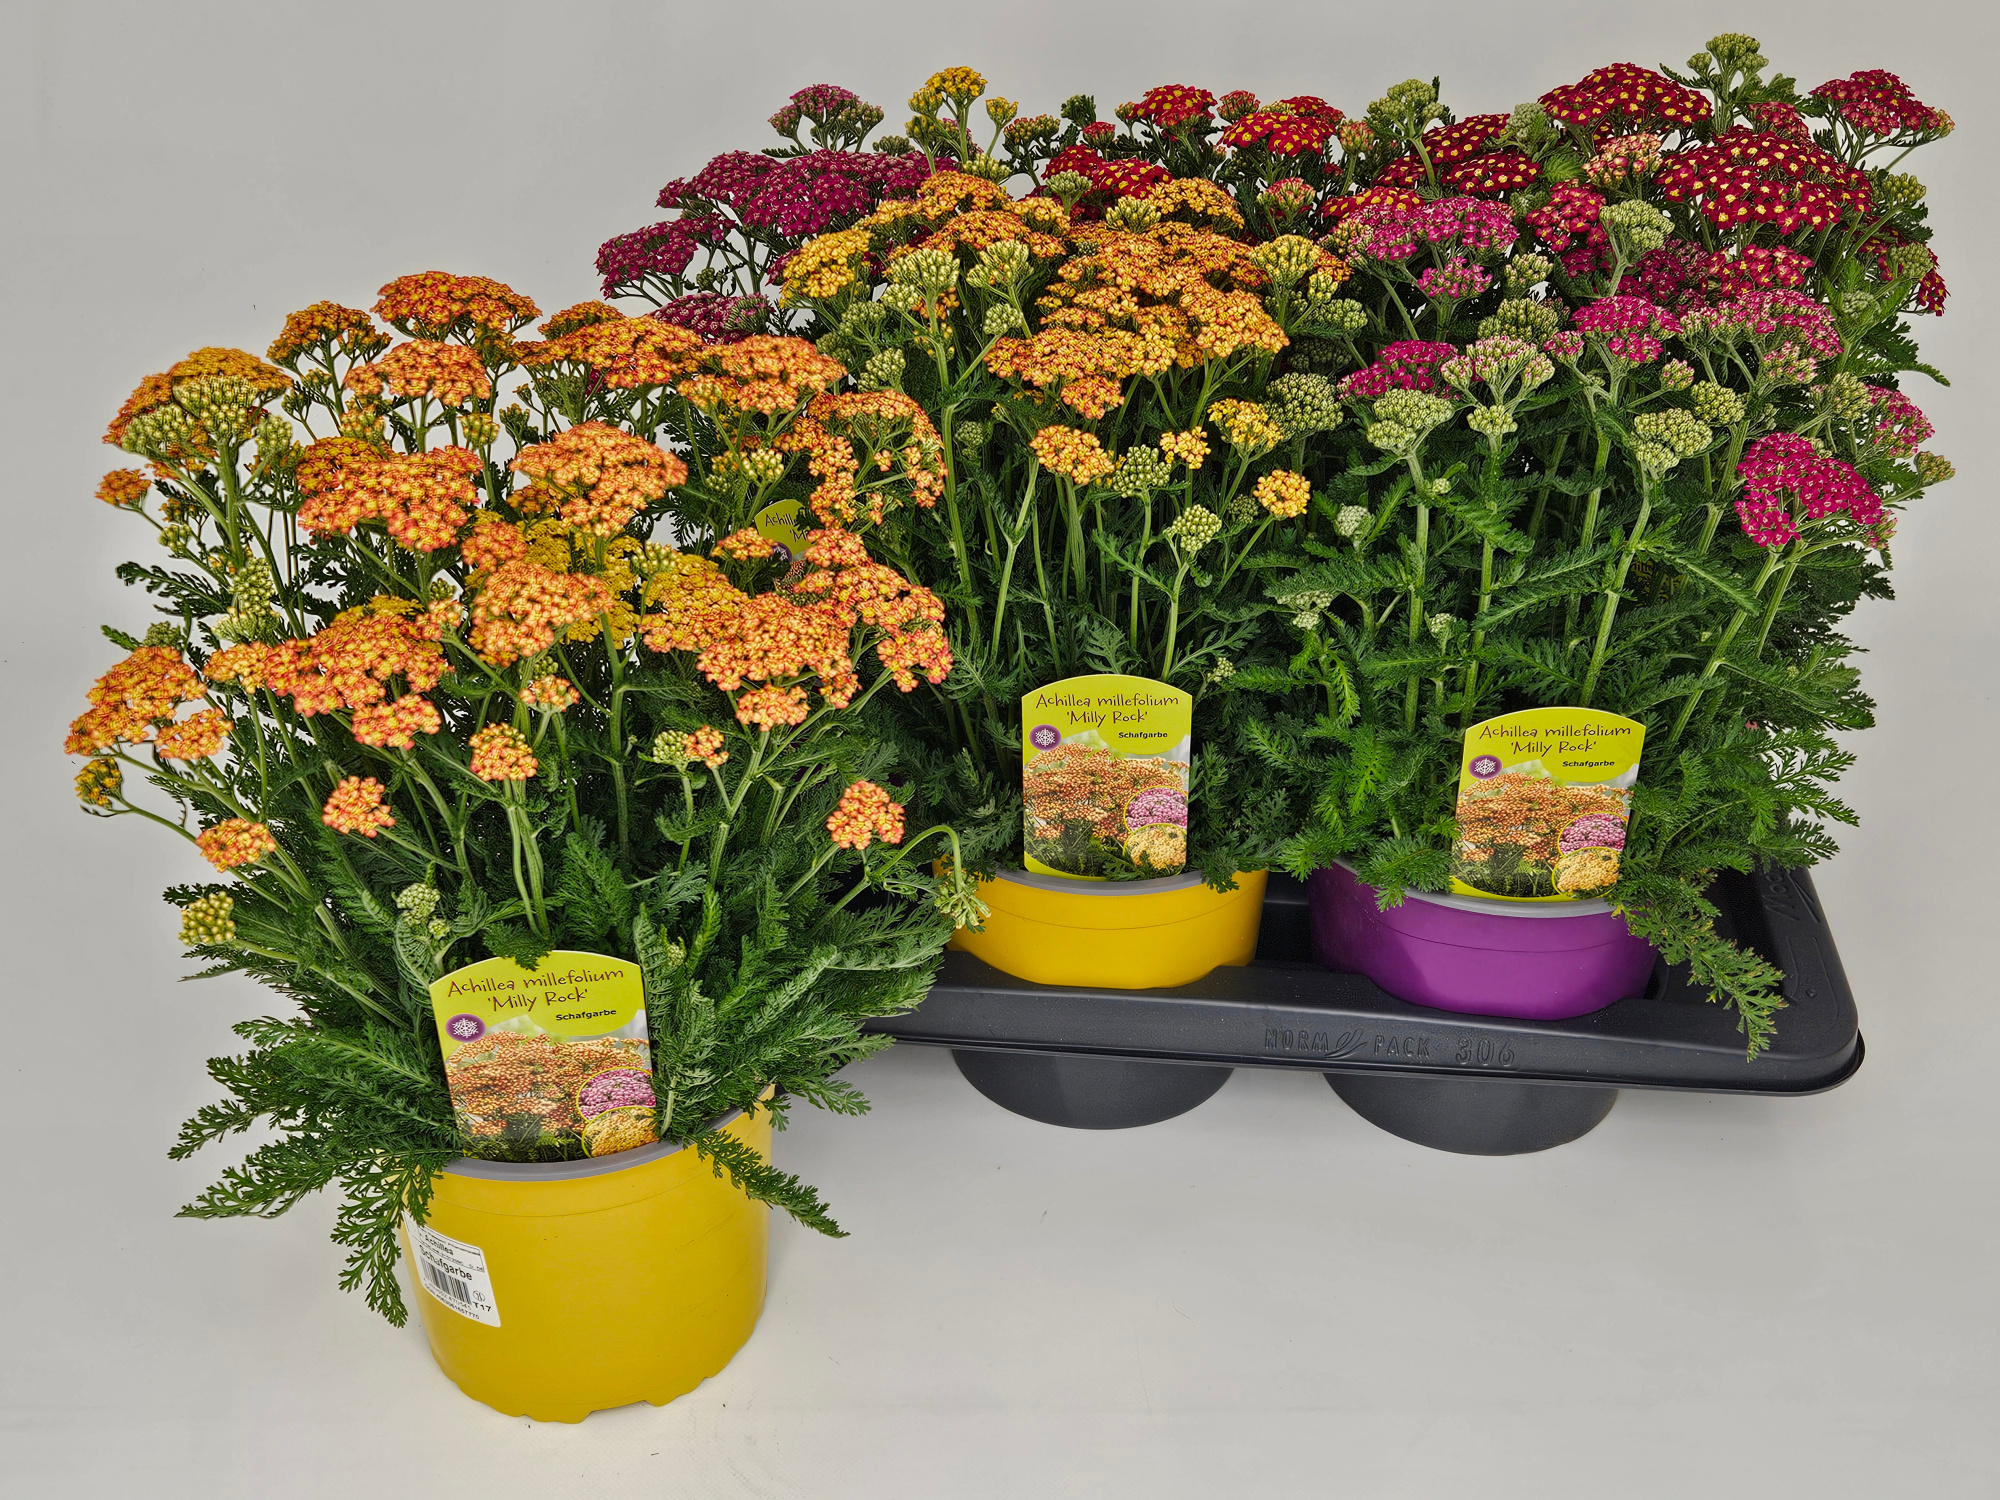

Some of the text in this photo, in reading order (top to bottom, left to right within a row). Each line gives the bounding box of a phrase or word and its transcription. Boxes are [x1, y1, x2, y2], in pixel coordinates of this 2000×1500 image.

[1035, 692, 1179, 709] Achillea millefolium
[1066, 708, 1149, 728] 'Milly Rock'
[1118, 731, 1168, 740] Schafgarbe
[1479, 724, 1632, 740] Achillea millefolium
[1510, 738, 1597, 757] 'Milly Rock'
[1562, 759, 1615, 768] Schafgarbe
[448, 969, 624, 997] Achillea millefolium
[487, 986, 588, 1012] 'Milly Rock'
[555, 1008, 617, 1022] Schafgarbe
[1264, 1027, 1515, 1067] NORM PACK 306
[419, 1244, 473, 1281] Schafgarbe
[472, 1301, 492, 1312] T17
